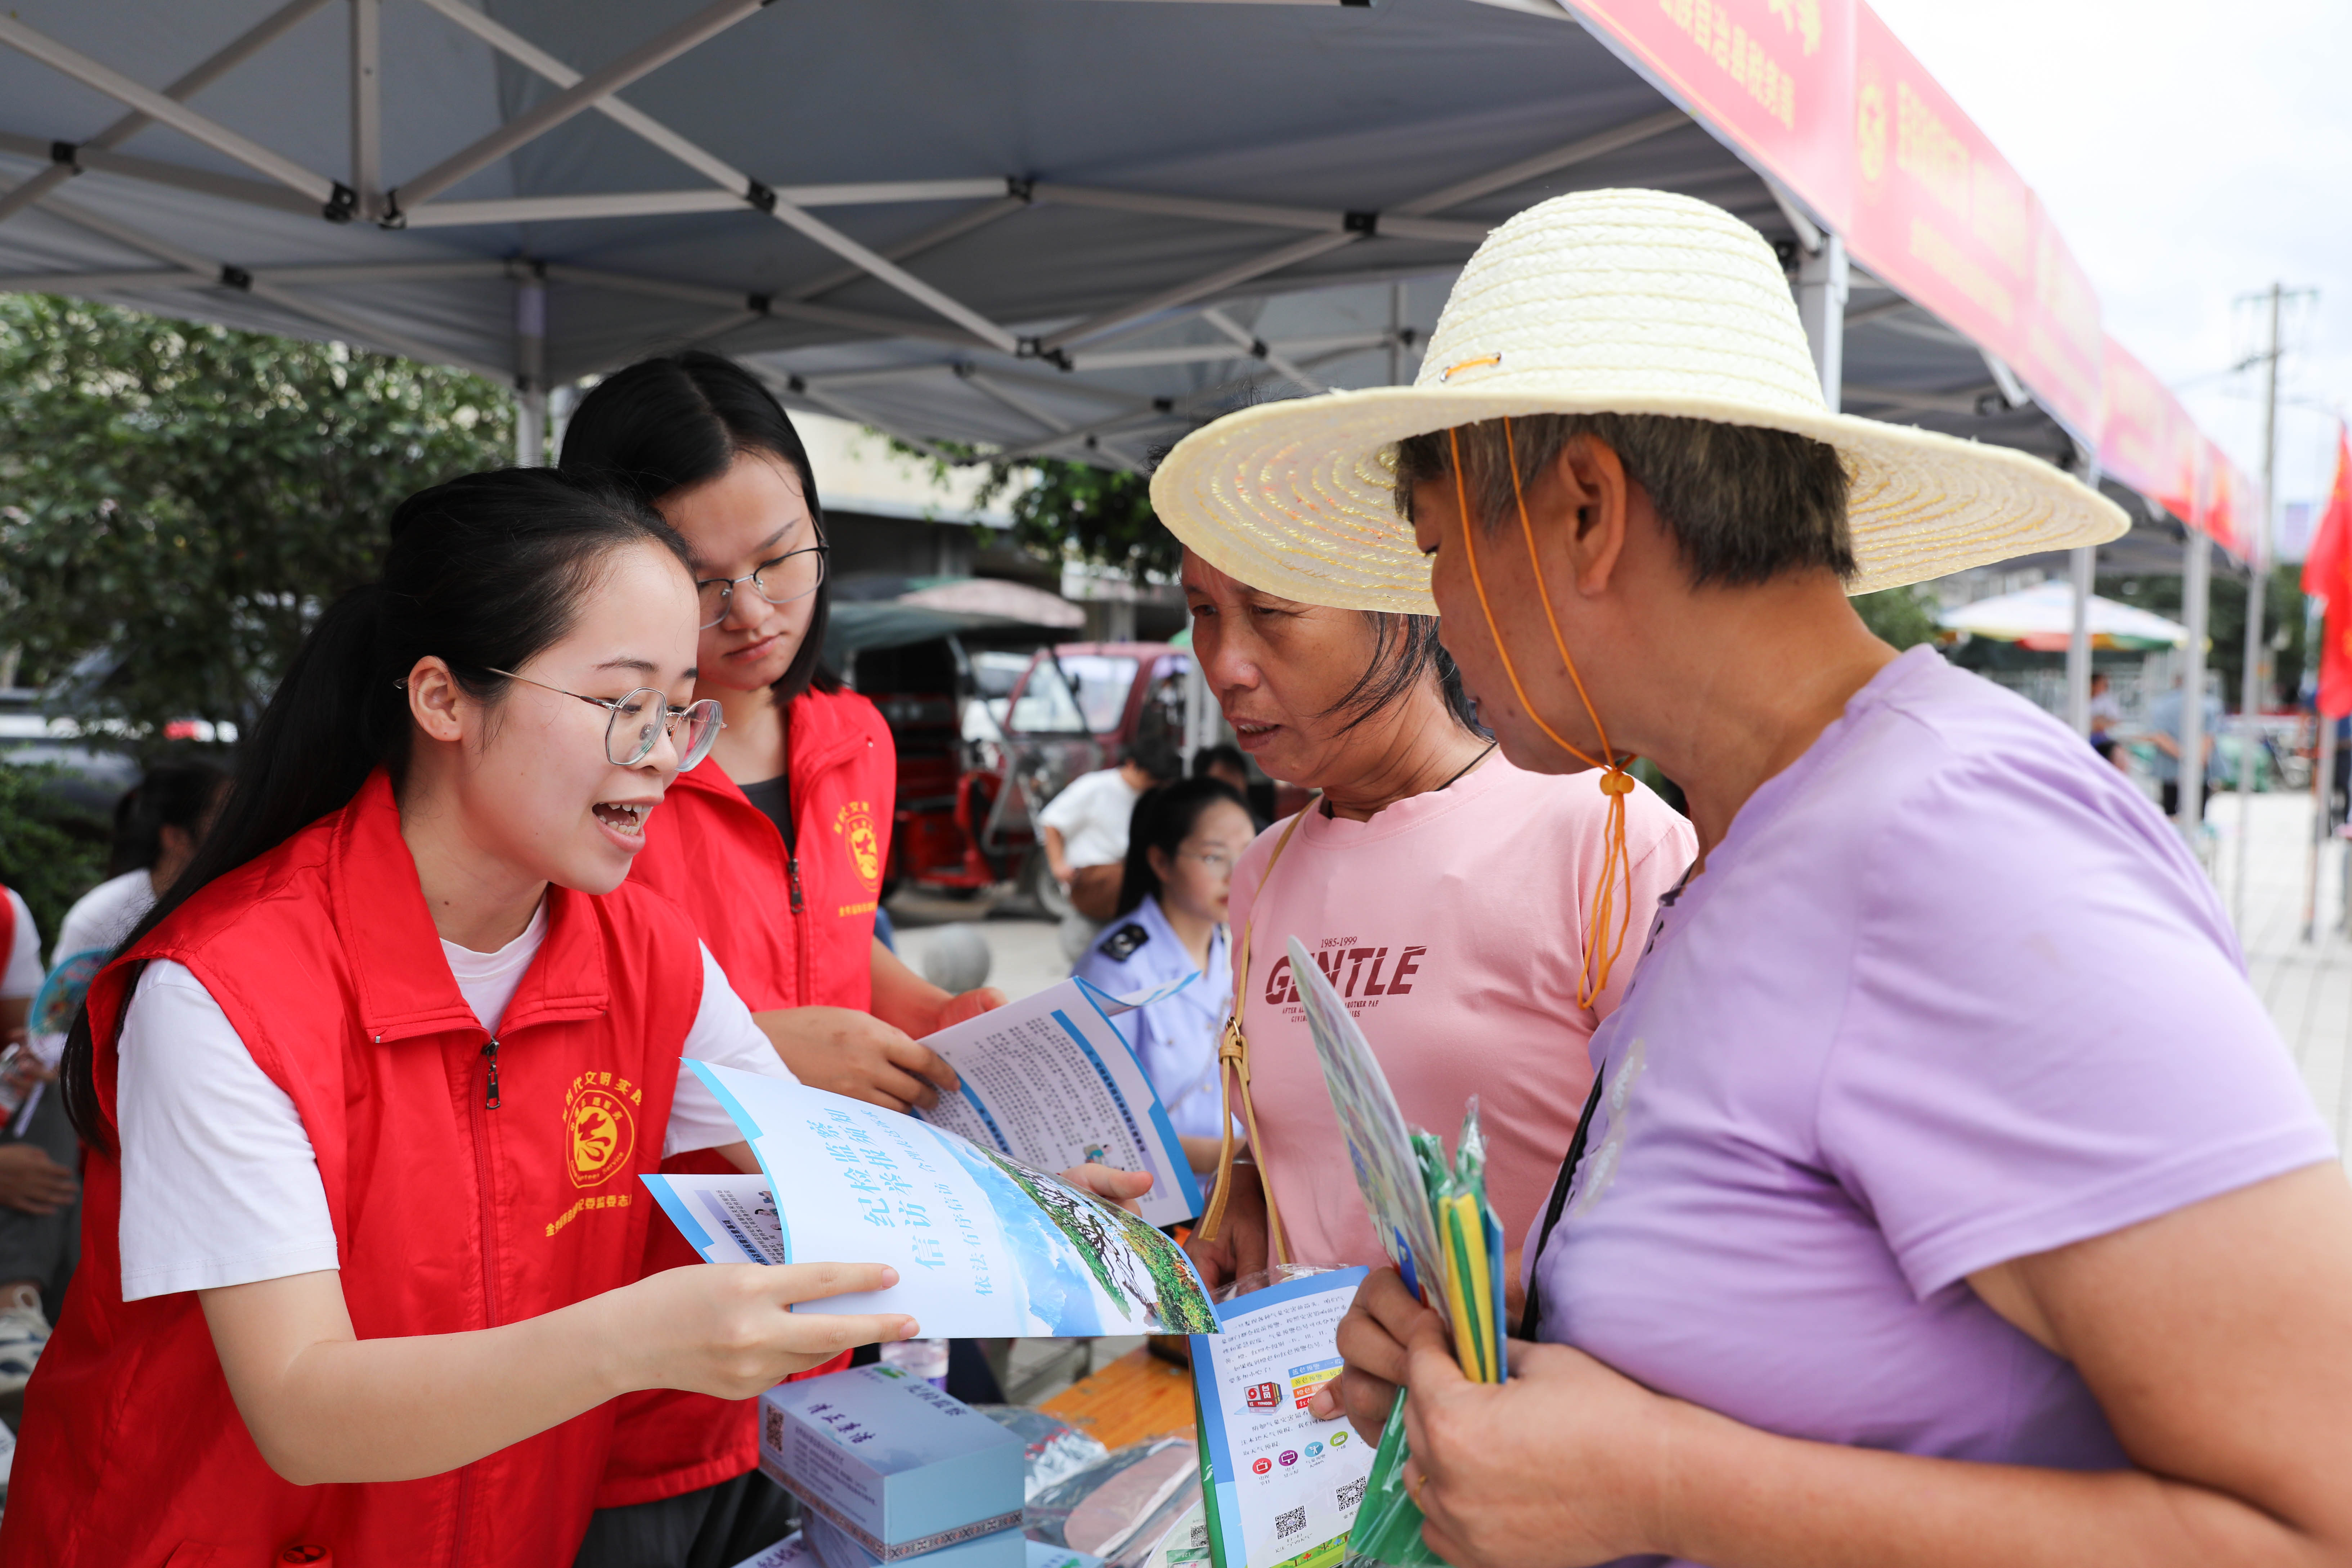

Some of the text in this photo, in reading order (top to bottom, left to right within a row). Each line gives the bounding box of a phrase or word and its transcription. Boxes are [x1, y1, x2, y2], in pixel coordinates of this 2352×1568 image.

[1321, 936, 1357, 948] 1985-1999
[807, 1120, 896, 1228] 纪检监察
[860, 1109, 937, 1173] 合理表达诉求
[823, 1108, 946, 1271] 信访举报须知
[934, 1182, 993, 1297] 依法有序信访
[1262, 1384, 1271, 1399] 台风
